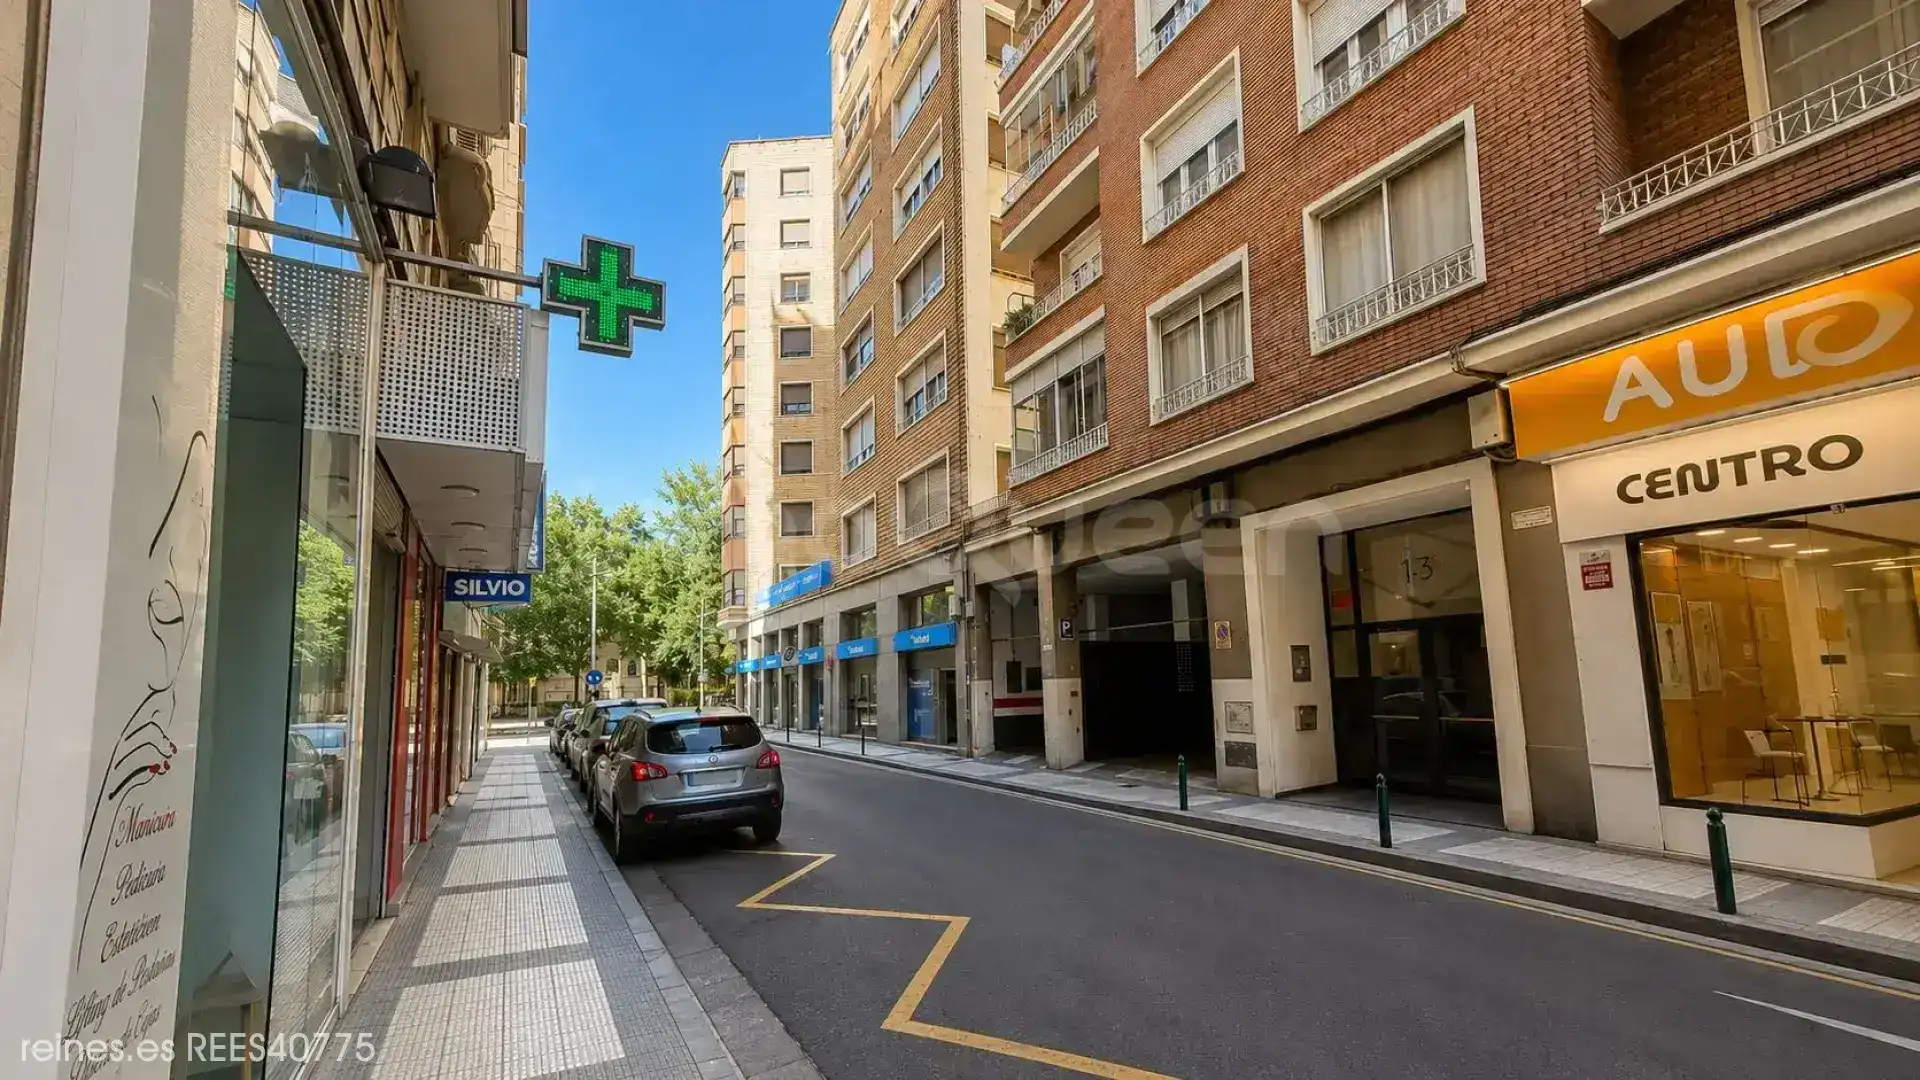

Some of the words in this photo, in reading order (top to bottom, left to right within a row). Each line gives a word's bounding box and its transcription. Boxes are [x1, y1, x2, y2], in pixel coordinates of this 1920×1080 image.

[1616, 433, 1864, 505] CENTRO
[454, 578, 525, 597] SILVIO
[1062, 620, 1071, 635] P
